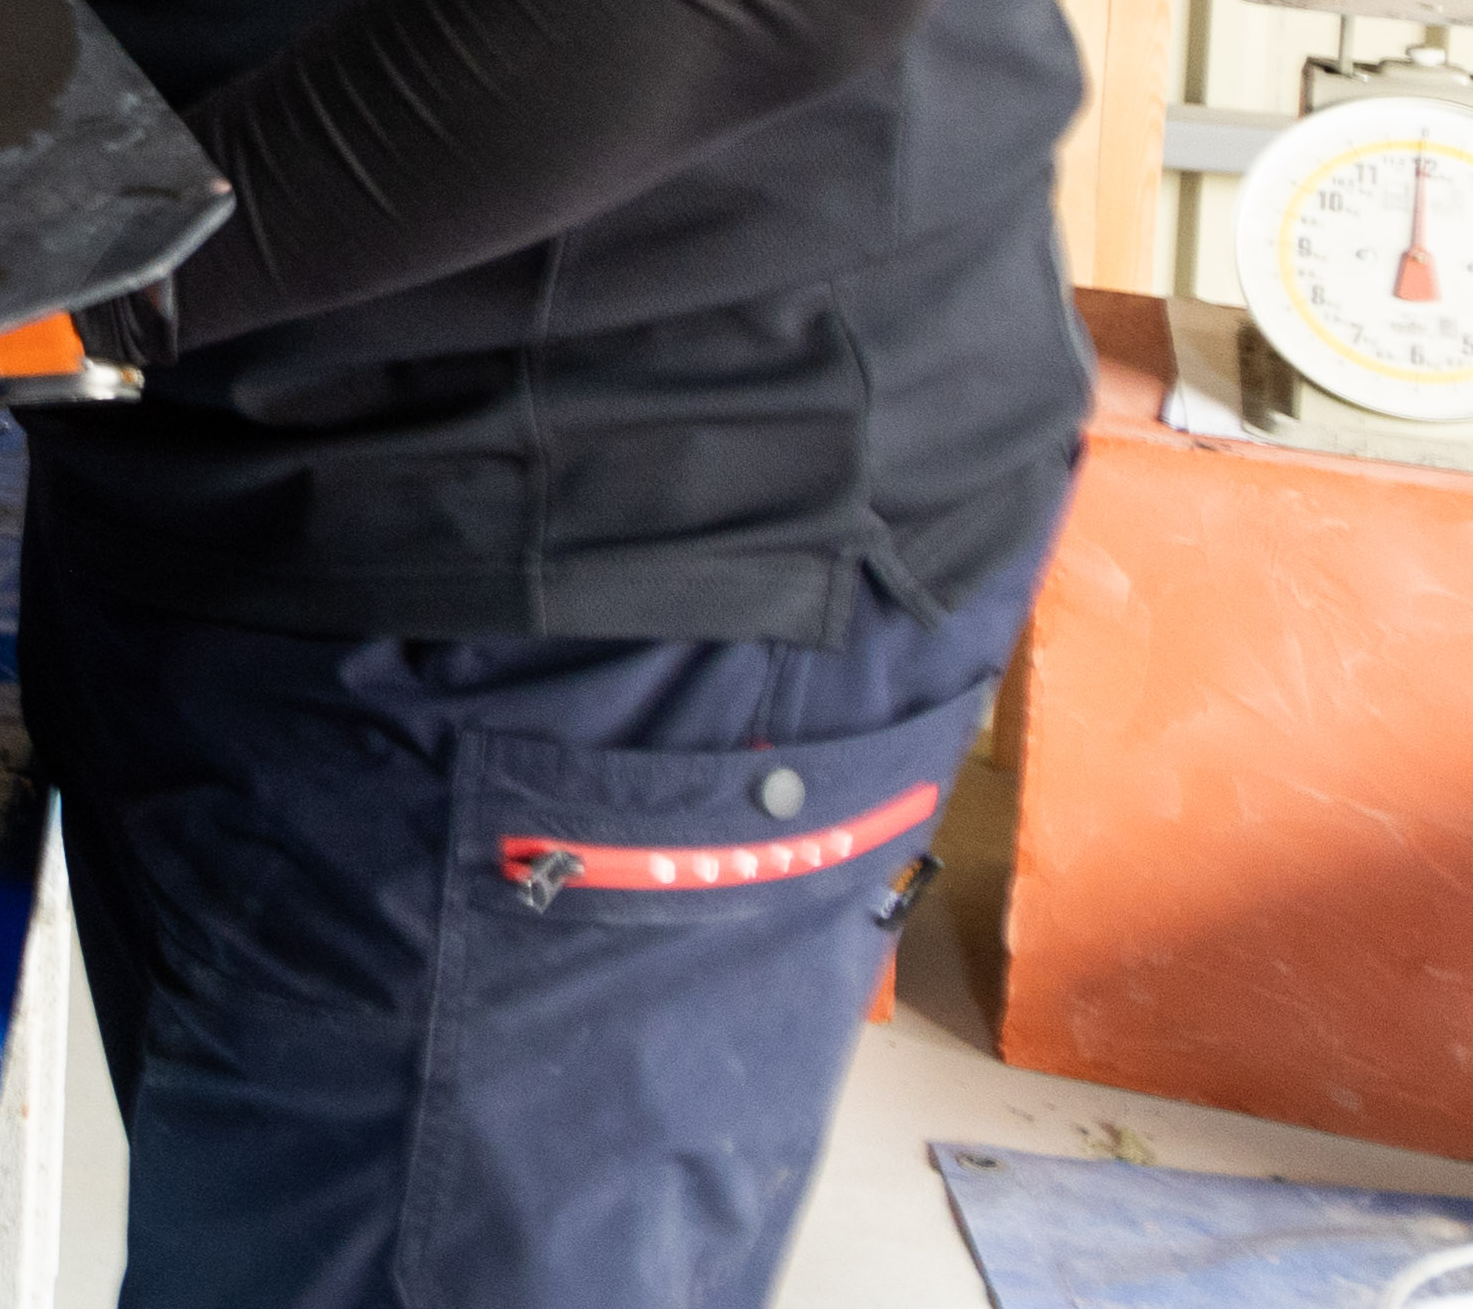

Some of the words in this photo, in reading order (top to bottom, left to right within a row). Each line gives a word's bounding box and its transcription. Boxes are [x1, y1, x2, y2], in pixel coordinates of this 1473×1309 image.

[1356, 163, 1378, 185] 11
[1318, 190, 1343, 213] 10
[1297, 237, 1312, 257] 9
[1311, 285, 1325, 305] 8
[1410, 344, 1425, 365] 6
